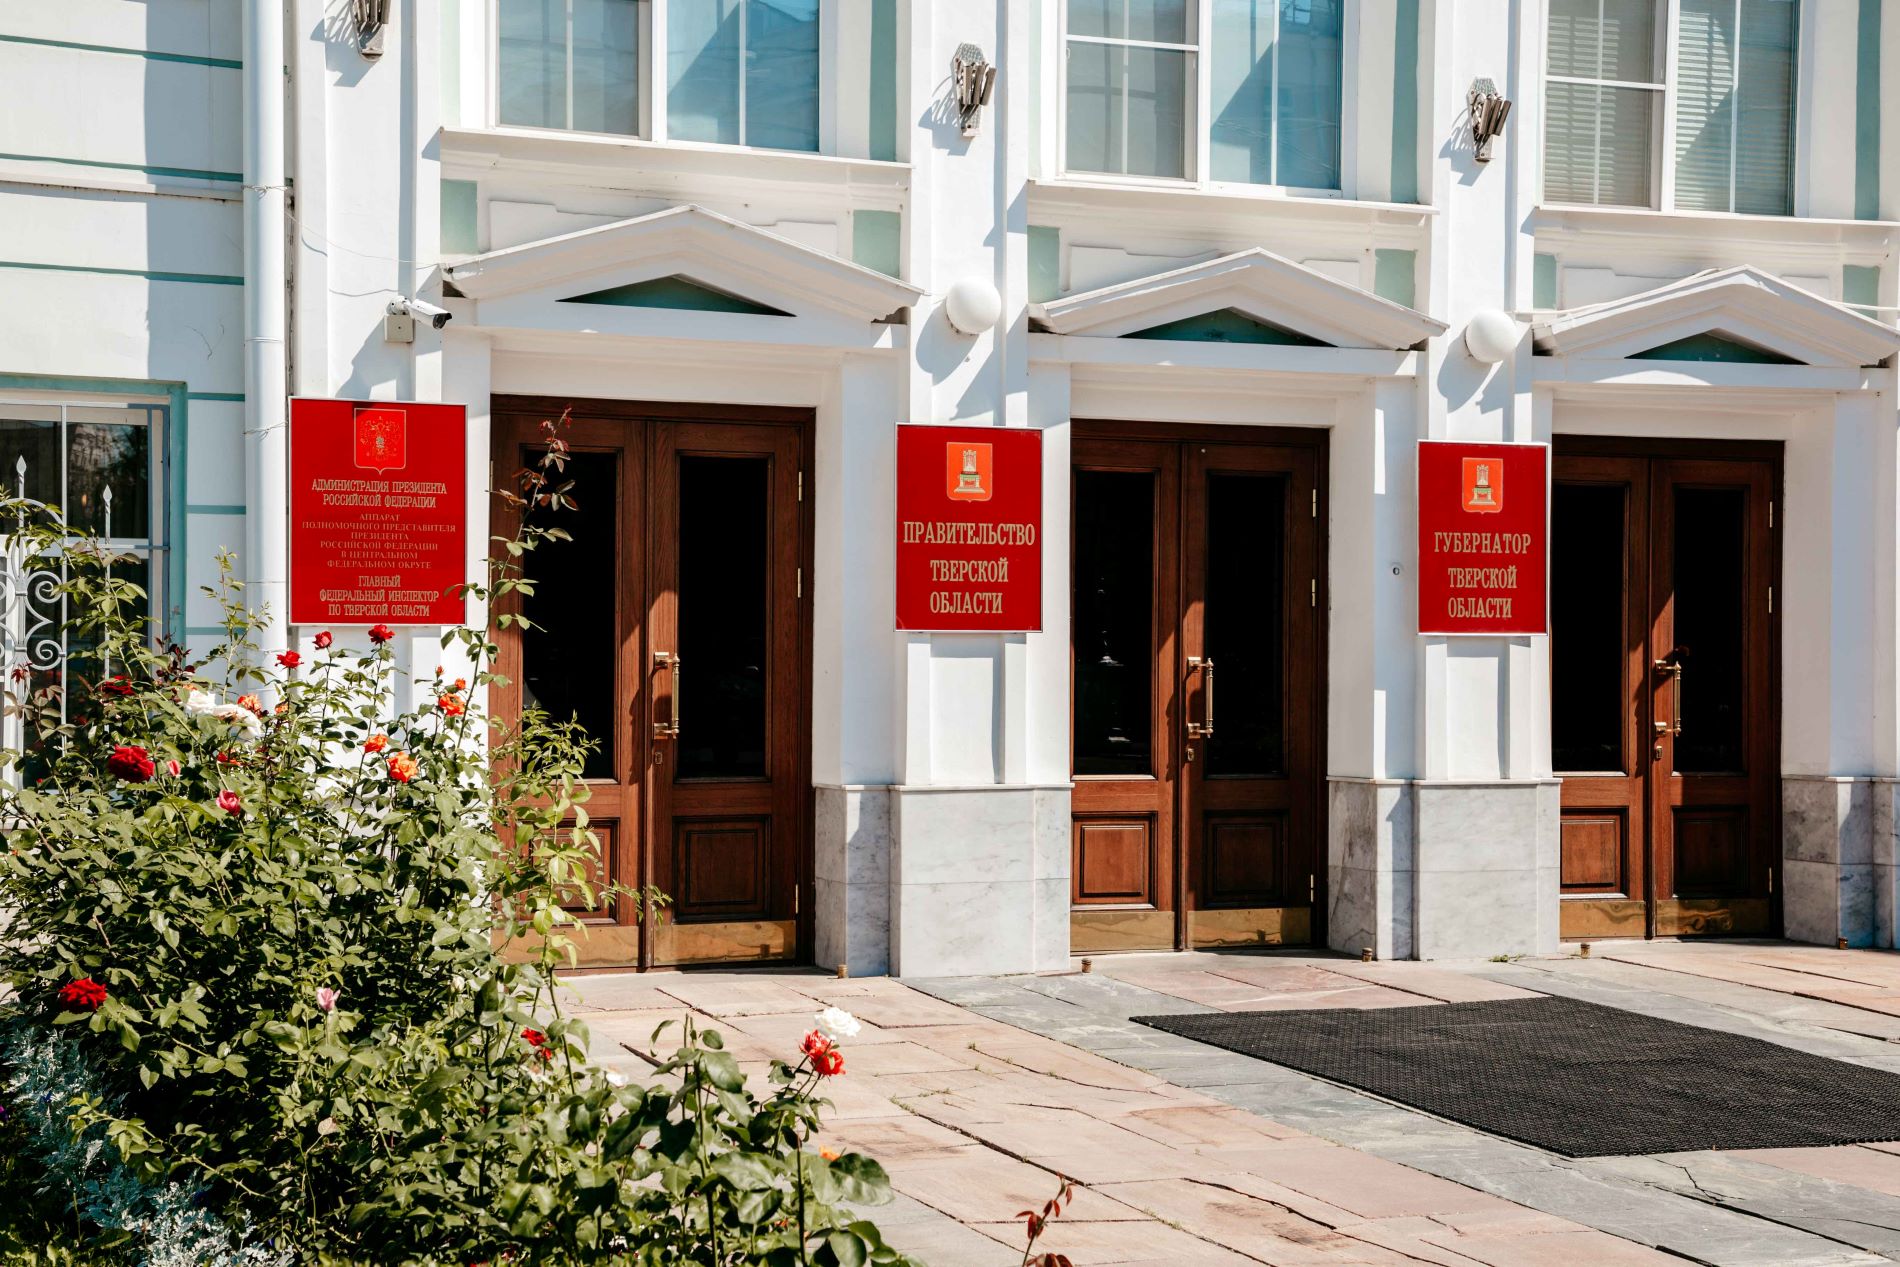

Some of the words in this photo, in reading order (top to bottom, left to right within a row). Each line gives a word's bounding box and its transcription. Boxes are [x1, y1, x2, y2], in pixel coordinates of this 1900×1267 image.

[312, 479, 389, 493] АДМИНИСТРАЦИЯ
[392, 482, 447, 494] ПРЕЗИДЕНТА
[323, 493, 382, 507] РОССИЙСКОЙ
[384, 496, 436, 508] ФЕДЕРАЦИИ
[359, 513, 400, 521] АППАРАТ
[302, 521, 380, 531] ПОЛНОМОЧНОГО
[382, 523, 456, 532] ПРЕДСТАВИТЕЛЯ
[903, 521, 1036, 546] ПРАВИТЕЛЬСТВО
[351, 531, 409, 540] ПРЕЗИДЕНТА
[1434, 531, 1532, 554] ГУБЕРНАТОР
[320, 540, 381, 550] РОССИЙСКОЙ
[384, 542, 438, 551] ФЕДЕРАЦИИ
[350, 551, 418, 560] ЦЕНТРАЛЬНОМ
[327, 560, 395, 569] ФЕДЕРАЛЬНОМ
[398, 561, 432, 569] ОКРУГЕ
[930, 557, 1009, 583] ТВЕРСКОЙ
[358, 575, 401, 587] ГЛАВНЫЙ
[1448, 565, 1518, 589] ТВЕРСКОЙ
[319, 589, 385, 602] ФЕДЕРАЛЬНЫЙ
[388, 591, 439, 602] ИНСПЕКТОР
[930, 591, 1003, 614] ОБЛАСТИ
[328, 604, 341, 616] ПО
[344, 603, 388, 616] ТВЕРСКОЙ
[391, 605, 430, 617] ОБЛАСТИ
[1448, 597, 1512, 619] ОБЛАСТИ
